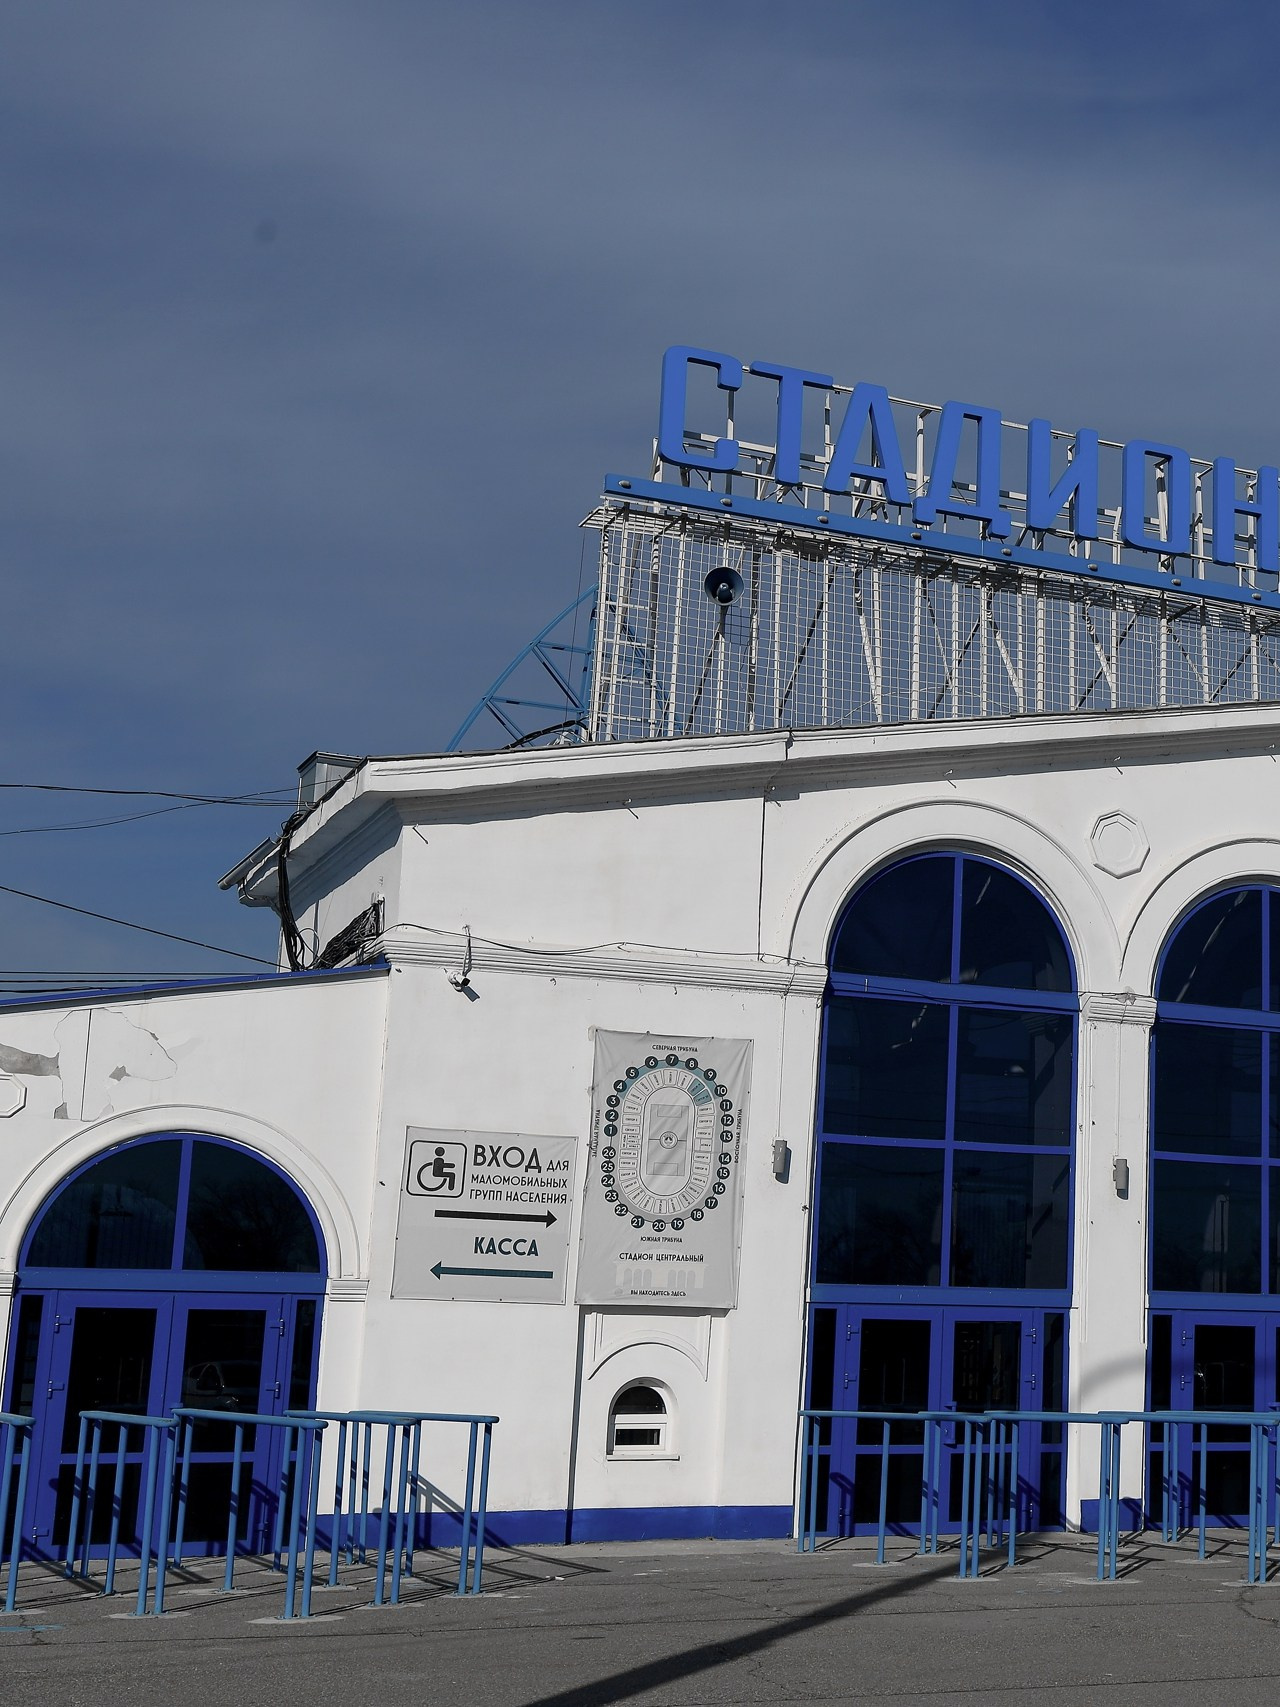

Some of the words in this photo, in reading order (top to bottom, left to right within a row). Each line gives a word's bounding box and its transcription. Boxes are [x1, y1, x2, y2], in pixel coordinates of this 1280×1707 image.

[657, 345, 1280, 574] СТАДИОН
[473, 1144, 542, 1174] ВХОД
[546, 1159, 569, 1172] ДЛЯ
[471, 1174, 568, 1188] МАЛОМОБИЛЬНЫХ
[470, 1189, 502, 1200] ГРУПП
[506, 1191, 567, 1204] НАСЕЛЕНИЯ
[474, 1236, 538, 1256] КАССА
[619, 1252, 653, 1261] СТАДИОН
[656, 1254, 704, 1262] ЦЕНТРАЛЬНЫЙ
